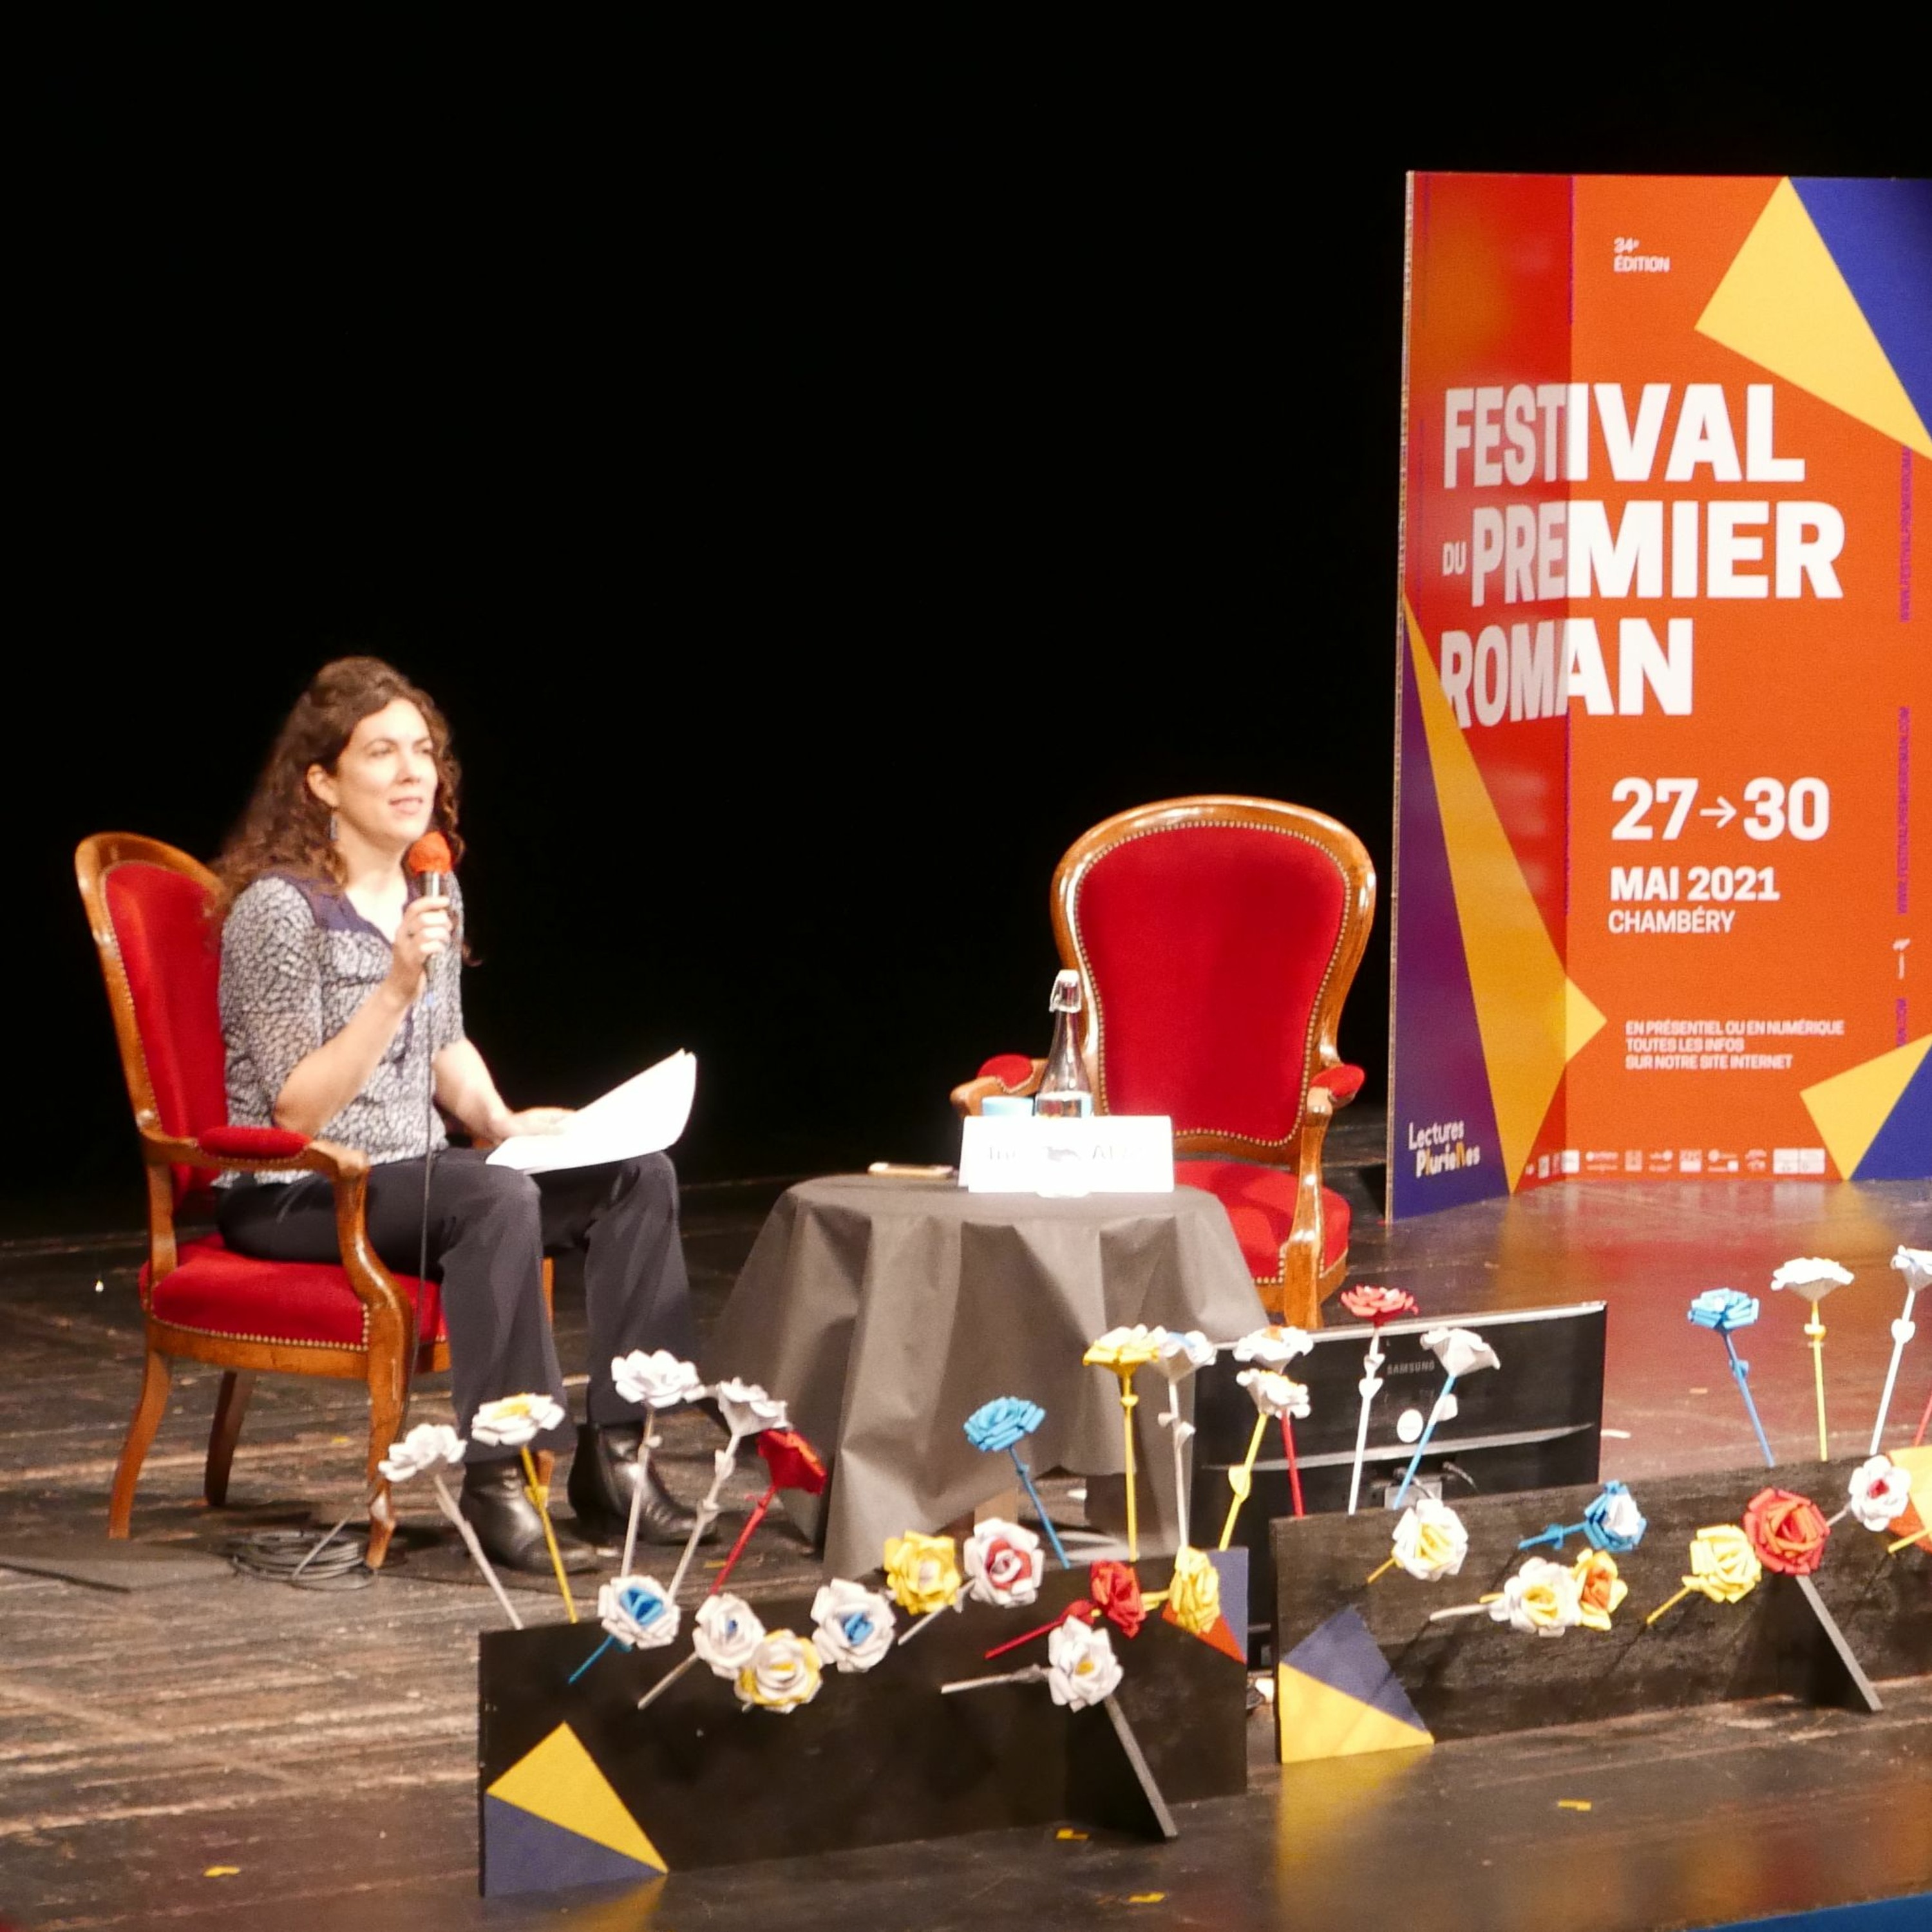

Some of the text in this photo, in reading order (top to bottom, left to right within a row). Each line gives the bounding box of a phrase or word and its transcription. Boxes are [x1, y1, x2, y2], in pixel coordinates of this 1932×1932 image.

[1614, 254, 1671, 272] ÉDITION
[1443, 383, 1806, 489] FESTIVAL
[1443, 500, 1846, 607] DU PREMIER
[1440, 618, 1694, 729] ROMAN
[1611, 867, 1781, 901] MAI 2021
[1609, 905, 1736, 934] CHAMBÉRY
[1625, 1018, 1844, 1036] EN PRÉSENTIEL OU EN NUMÉRIQUE
[1626, 1037, 1745, 1053] TOUTES LES INFOS
[1625, 1054, 1793, 1070] SUR NOTRE SITE INTERNET
[1408, 1121, 1464, 1150] Lectures
[1387, 1360, 1435, 1376] SAMSUNG
